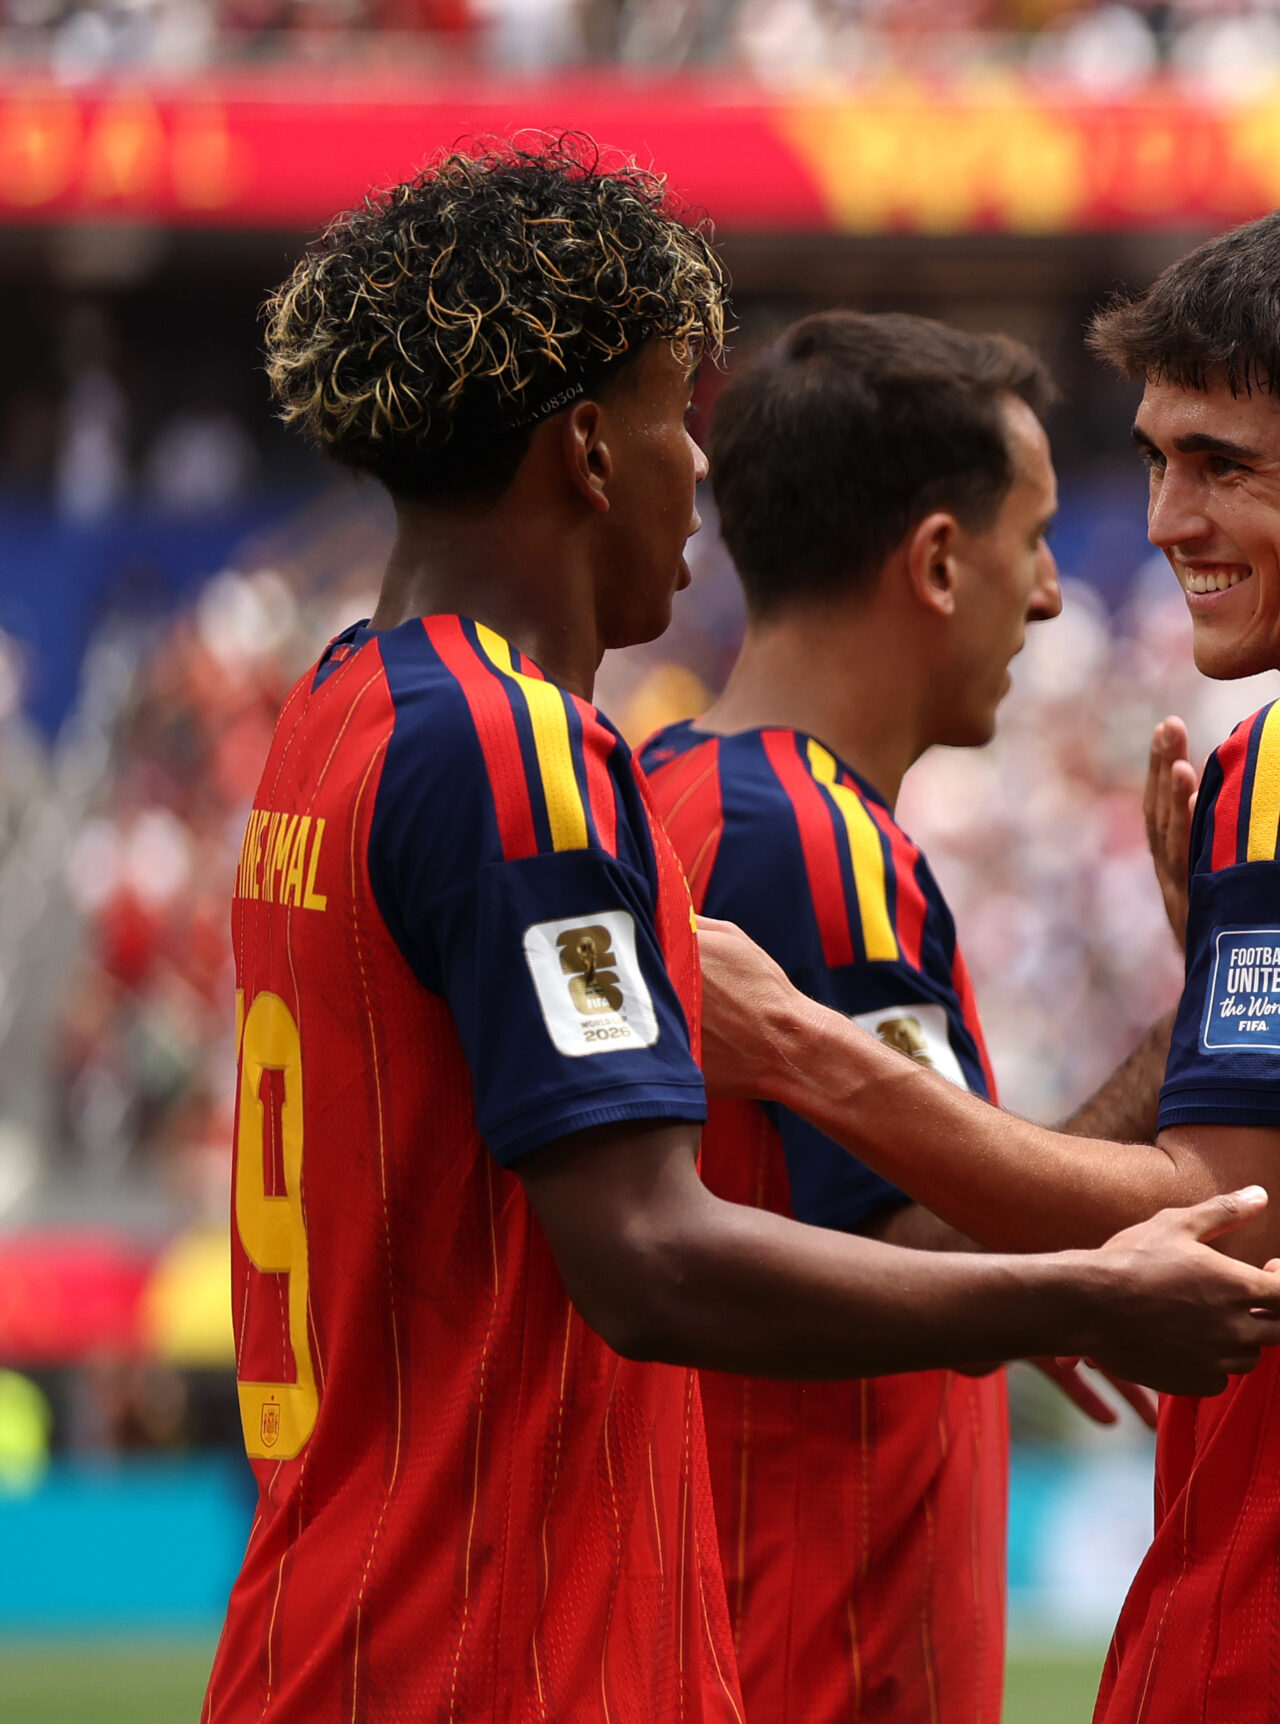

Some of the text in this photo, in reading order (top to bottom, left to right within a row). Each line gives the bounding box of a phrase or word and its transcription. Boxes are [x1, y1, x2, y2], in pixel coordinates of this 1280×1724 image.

[1219, 995, 1247, 1018] the
[583, 1026, 631, 1042] 2026
[1238, 1020, 1268, 1032] FIFA
